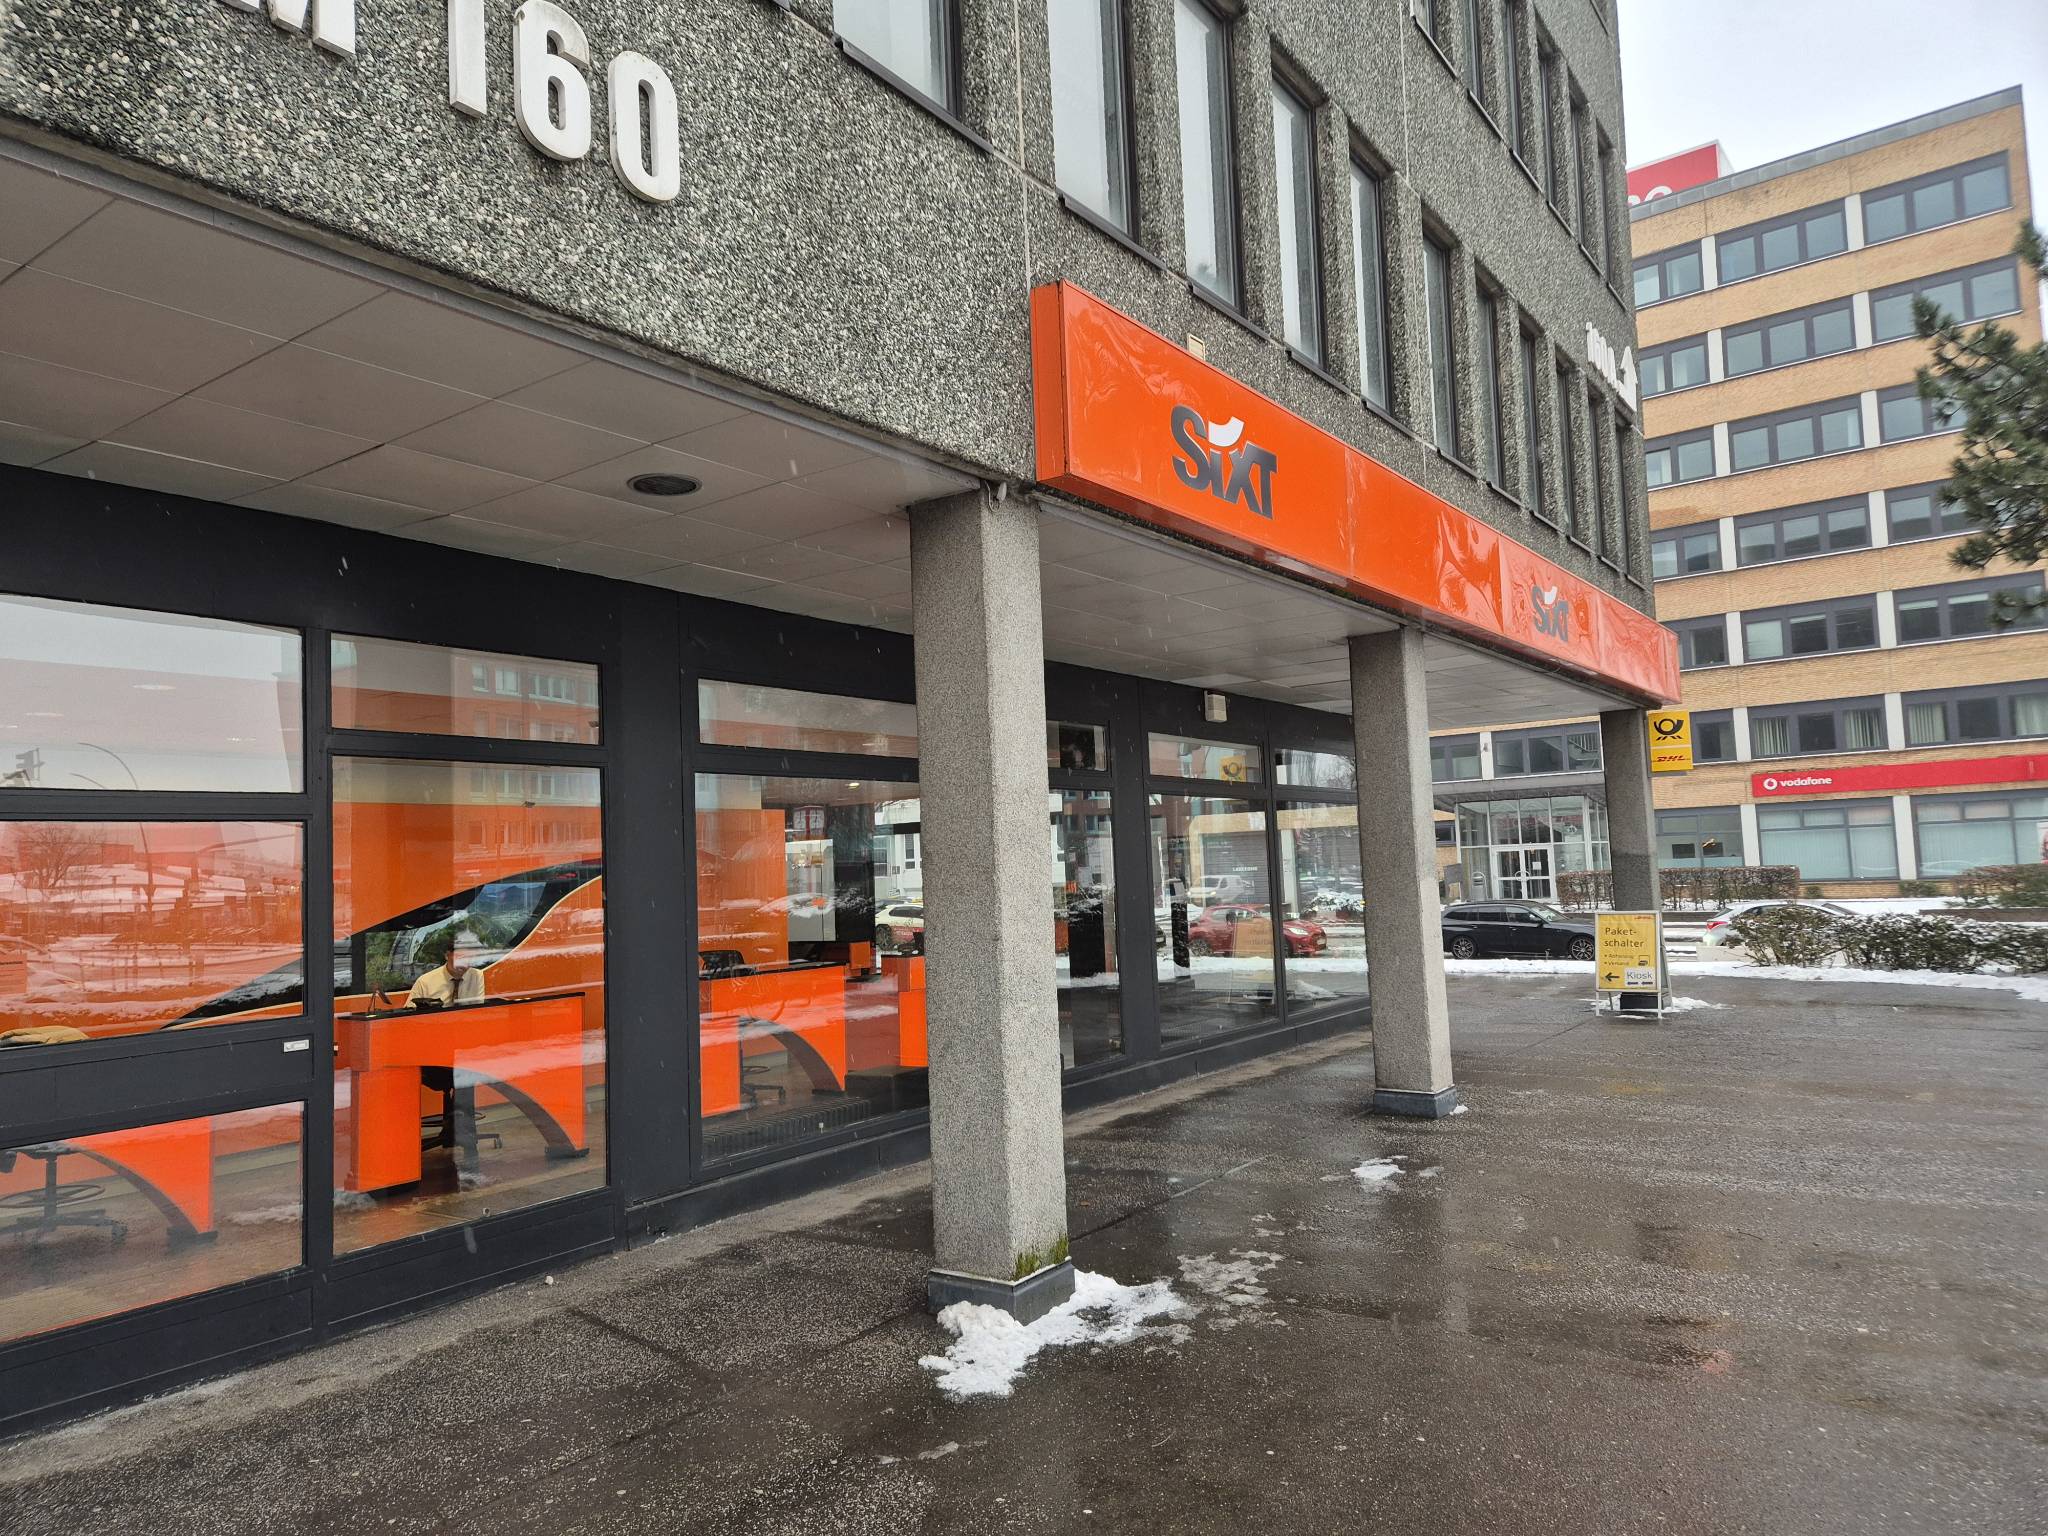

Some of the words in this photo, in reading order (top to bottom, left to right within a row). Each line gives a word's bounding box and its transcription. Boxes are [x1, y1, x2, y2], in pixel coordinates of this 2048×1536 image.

[448, 0, 681, 203] 160
[1780, 776, 1833, 787] vodafone
[1605, 927, 1637, 936] Paket-
[1603, 938, 1645, 948] schalter
[1626, 970, 1653, 980] Kiosk
